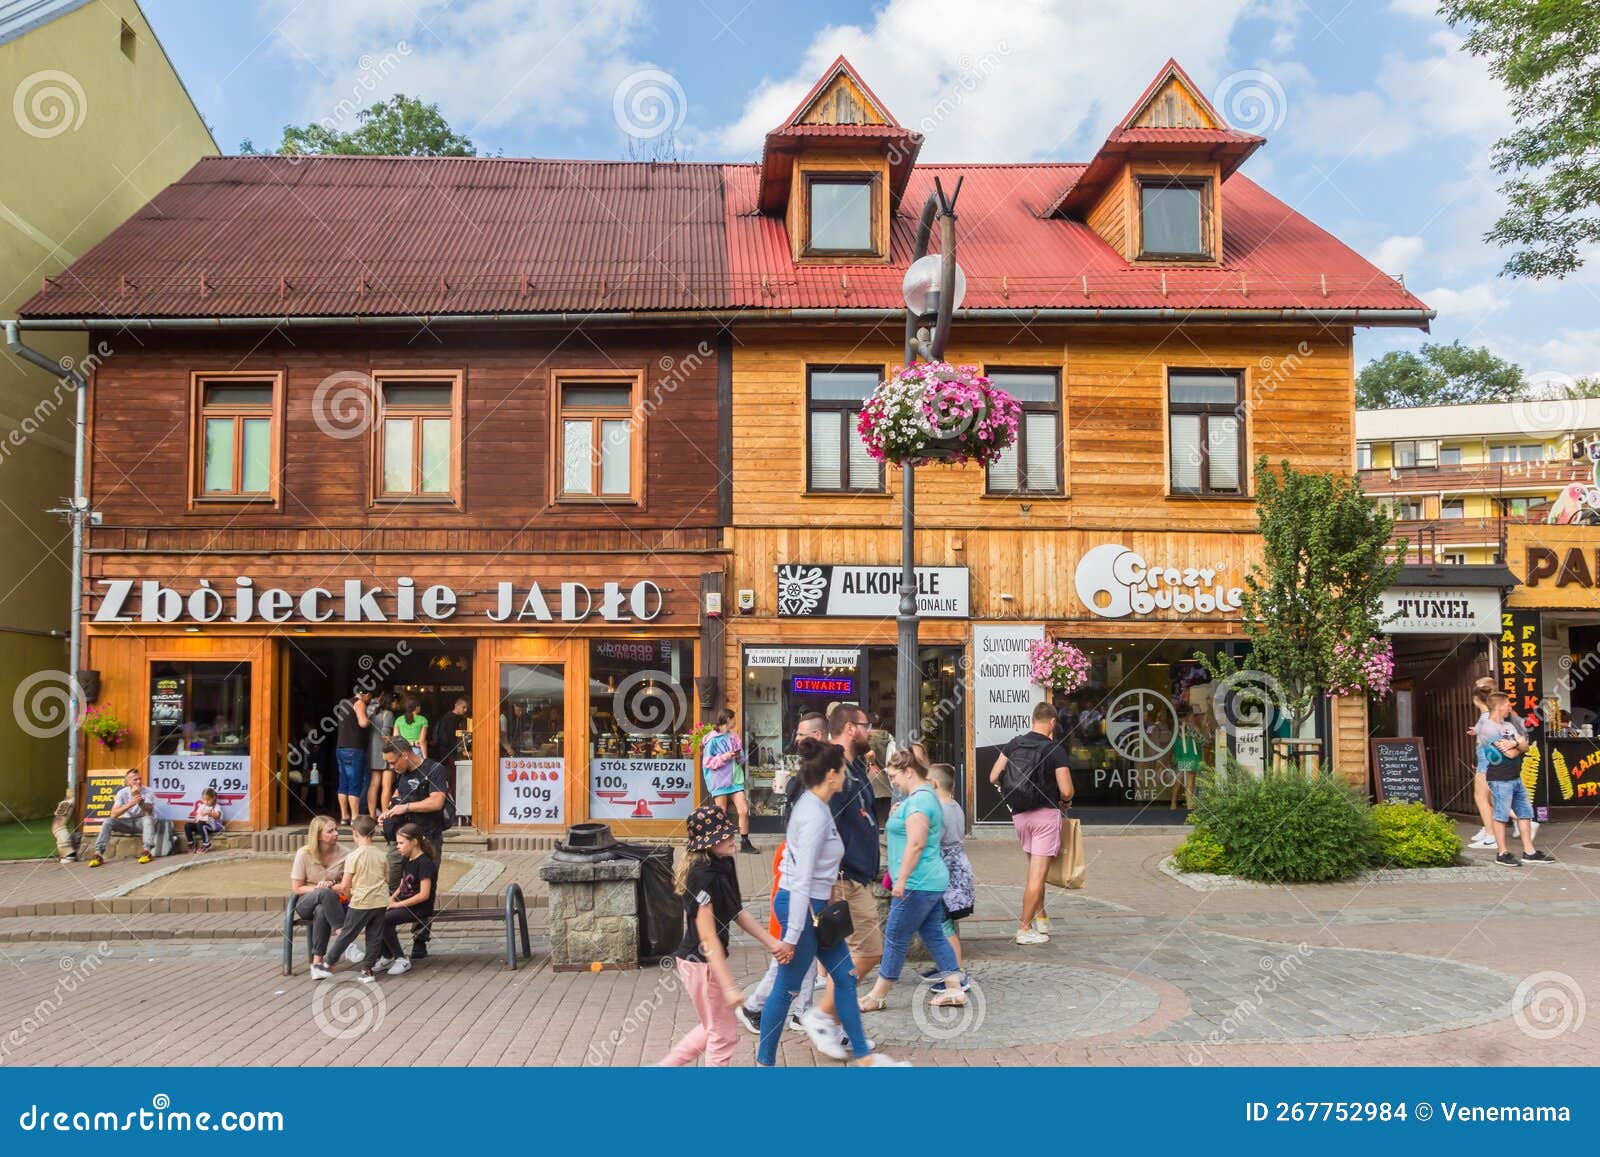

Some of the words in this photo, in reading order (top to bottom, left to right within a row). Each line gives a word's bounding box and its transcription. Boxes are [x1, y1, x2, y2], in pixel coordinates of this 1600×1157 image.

[1526, 547, 1600, 588] PA
[486, 580, 662, 622] JADŁO
[1398, 600, 1475, 619] TUNEL
[751, 655, 786, 664] ŚLIWOWICE
[794, 656, 819, 664] BIMBRY
[826, 657, 854, 665] NALEWKI
[980, 664, 1010, 677] MIODY
[1013, 664, 1033, 677] PITN
[1522, 625, 1540, 727] FRYTKA
[796, 680, 850, 691] OTWARTE
[989, 690, 1030, 703] NALEWKI
[989, 715, 1031, 731] PAMIĄTKI
[158, 760, 185, 770] STÓŁ
[187, 761, 243, 771] SZWEDZKI
[600, 760, 627, 771] STÓŁ
[630, 762, 686, 772] SZWEDZKI
[1094, 767, 1193, 788] PARROT
[513, 786, 551, 802] 100g
[508, 806, 542, 820] 4,99
[545, 805, 559, 818] zł
